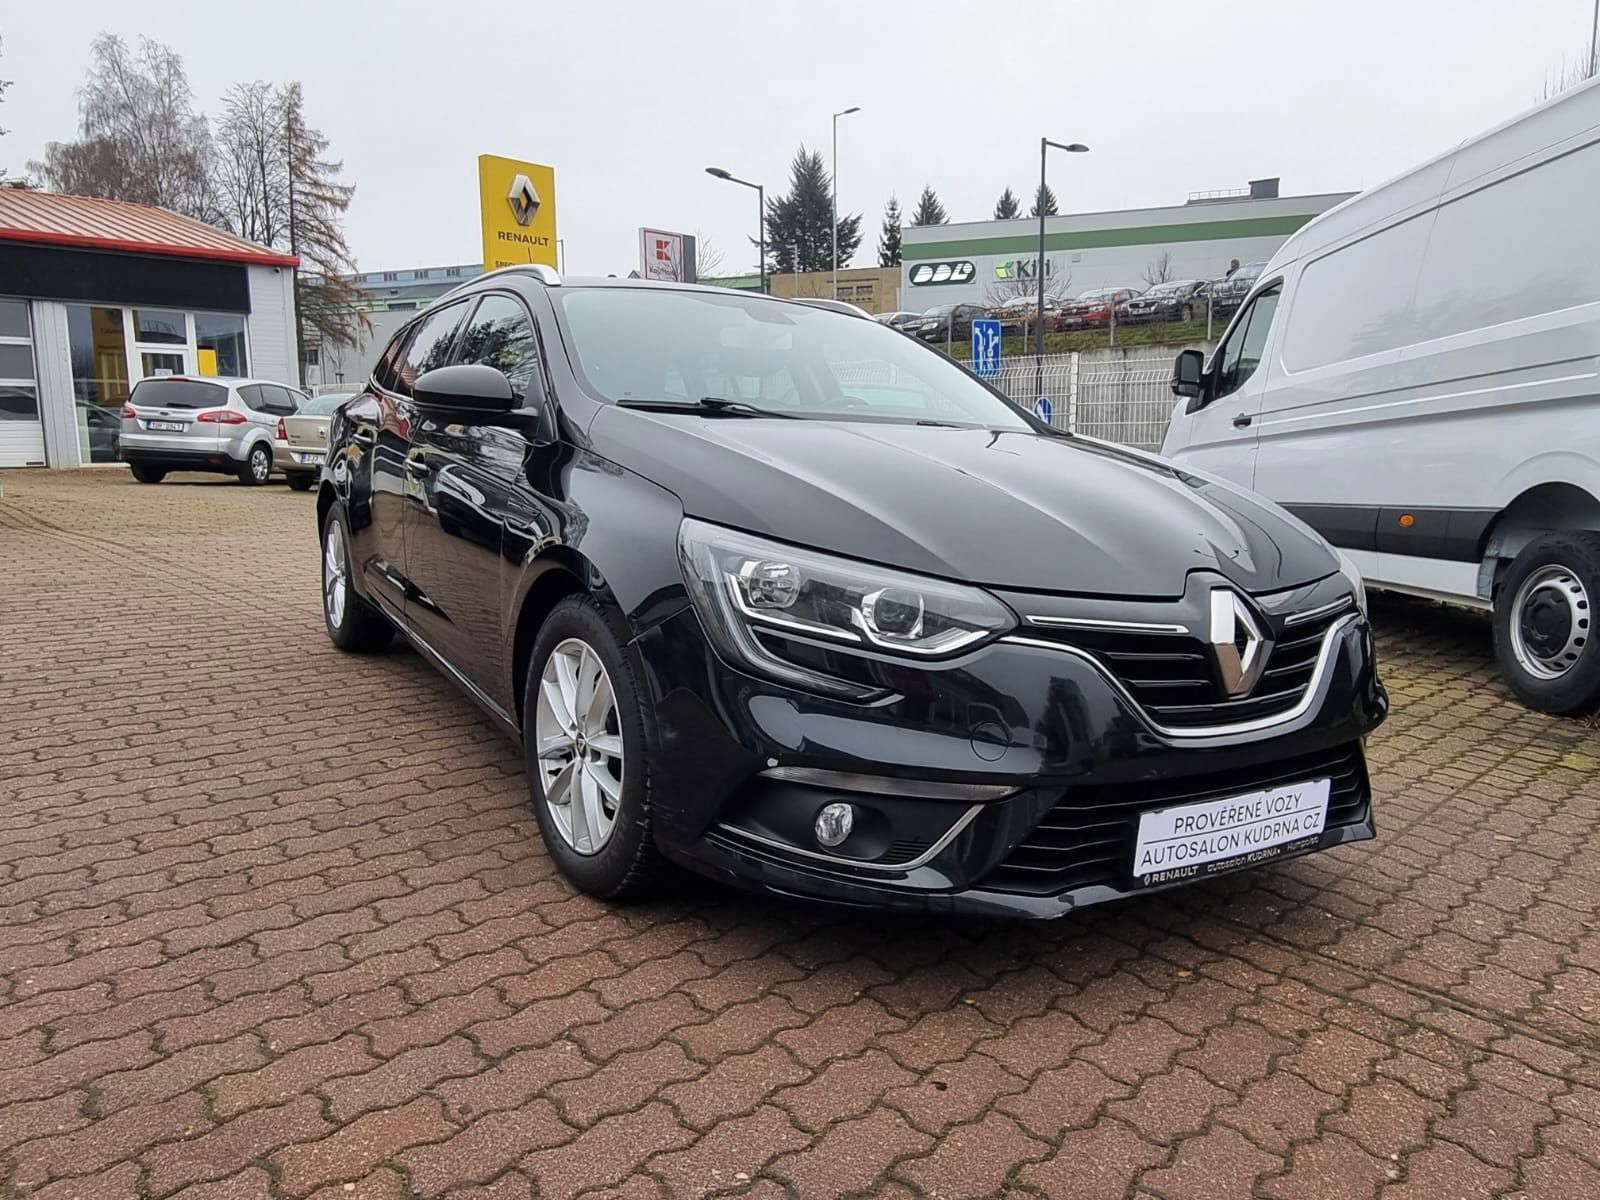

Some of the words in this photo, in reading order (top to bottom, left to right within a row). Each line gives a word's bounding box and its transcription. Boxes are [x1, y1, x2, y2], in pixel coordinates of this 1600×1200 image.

[497, 230, 549, 247] RENAULT
[1016, 259, 1051, 278] Kii
[1173, 799, 1263, 835] PROVĚŘENÉ
[1265, 793, 1303, 815] VOZY
[1140, 832, 1241, 868] AUTOSALON
[1243, 817, 1300, 845] KUDRNA
[1151, 865, 1199, 884] RENAULT
